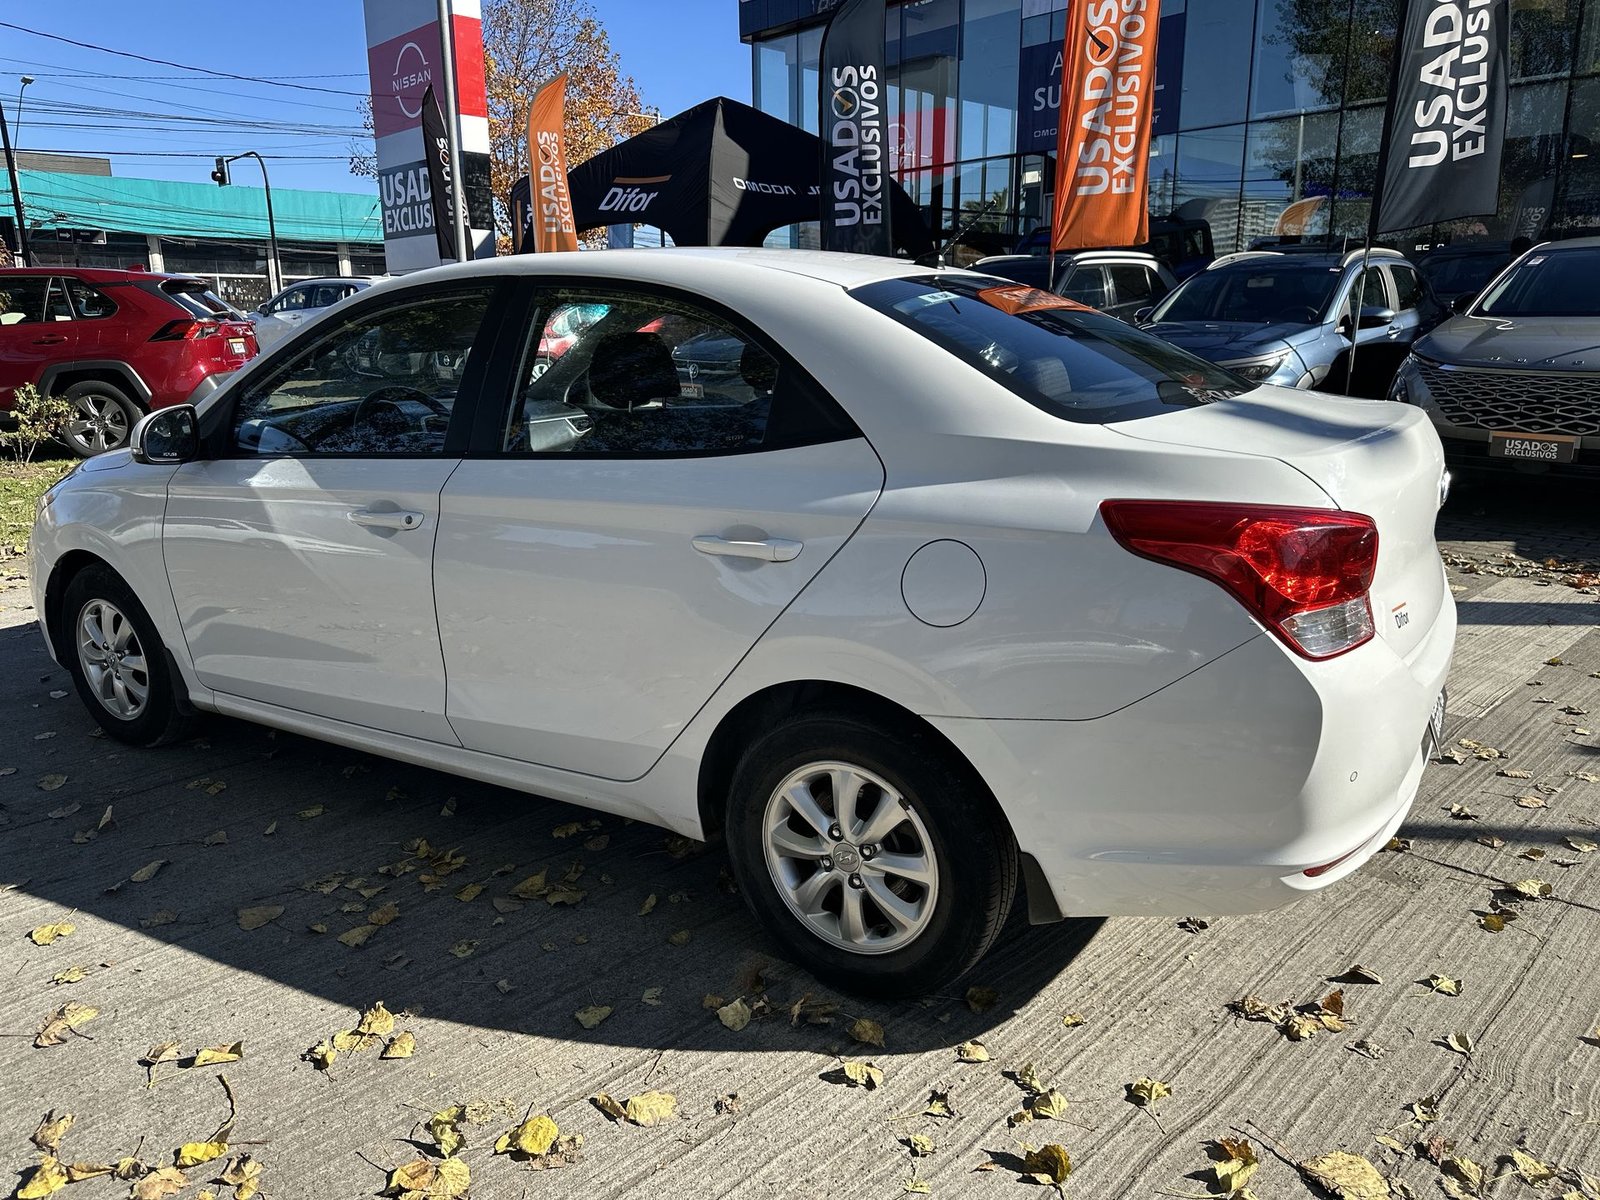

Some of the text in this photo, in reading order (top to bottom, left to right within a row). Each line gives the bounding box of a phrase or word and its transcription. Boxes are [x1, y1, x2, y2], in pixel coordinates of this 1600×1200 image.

[392, 69, 431, 91] NISSAN
[1077, 0, 1119, 196] USADOS
[1409, 0, 1463, 168] USAD
[1453, 0, 1491, 161] EXCLUSI
[831, 65, 860, 227] USADOS
[859, 64, 882, 225] EXCLUSIVOS
[381, 167, 432, 207] USAD
[537, 131, 560, 233] USADOS
[550, 132, 574, 233] EXCLUSIVOS
[598, 187, 659, 211] Difor
[733, 177, 796, 195] OMODA
[1504, 448, 1557, 459] EXCLUSIVOS
[1505, 439, 1558, 452] USADOS
[1394, 612, 1409, 629] Difor
